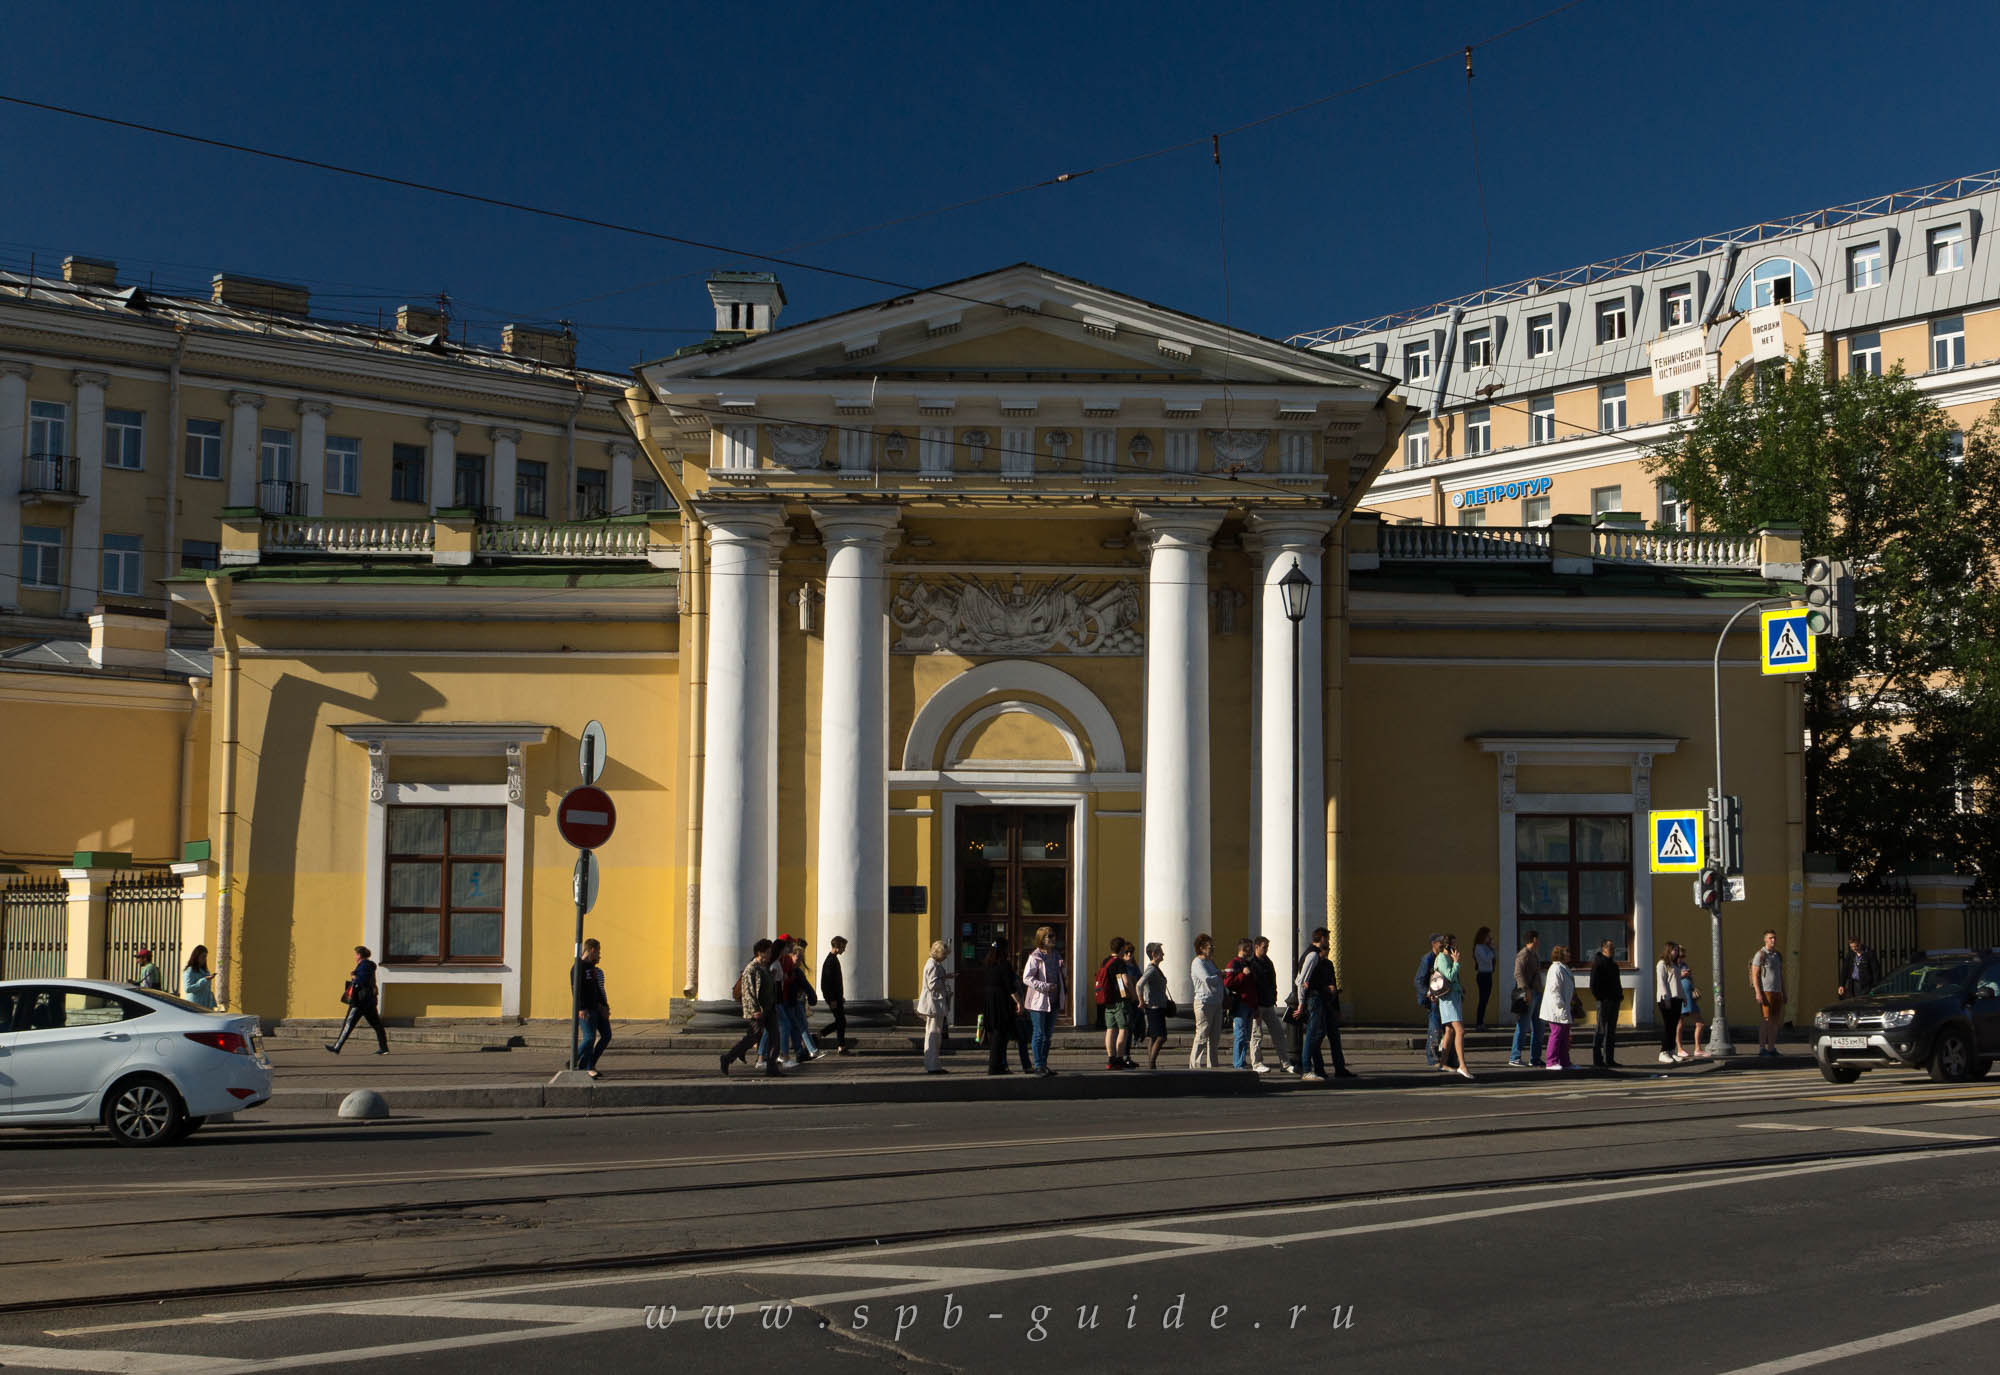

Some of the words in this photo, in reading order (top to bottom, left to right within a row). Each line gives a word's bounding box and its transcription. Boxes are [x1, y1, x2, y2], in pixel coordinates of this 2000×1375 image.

[1752, 320, 1780, 335] ПОСАДКИ
[1761, 335, 1774, 345] НЕТ
[1655, 346, 1703, 369] ТЕХНИЧЕСКАЯ
[1658, 360, 1701, 380] ОСТАНОВКА
[1465, 477, 1551, 506] ПЕТРОТУР
